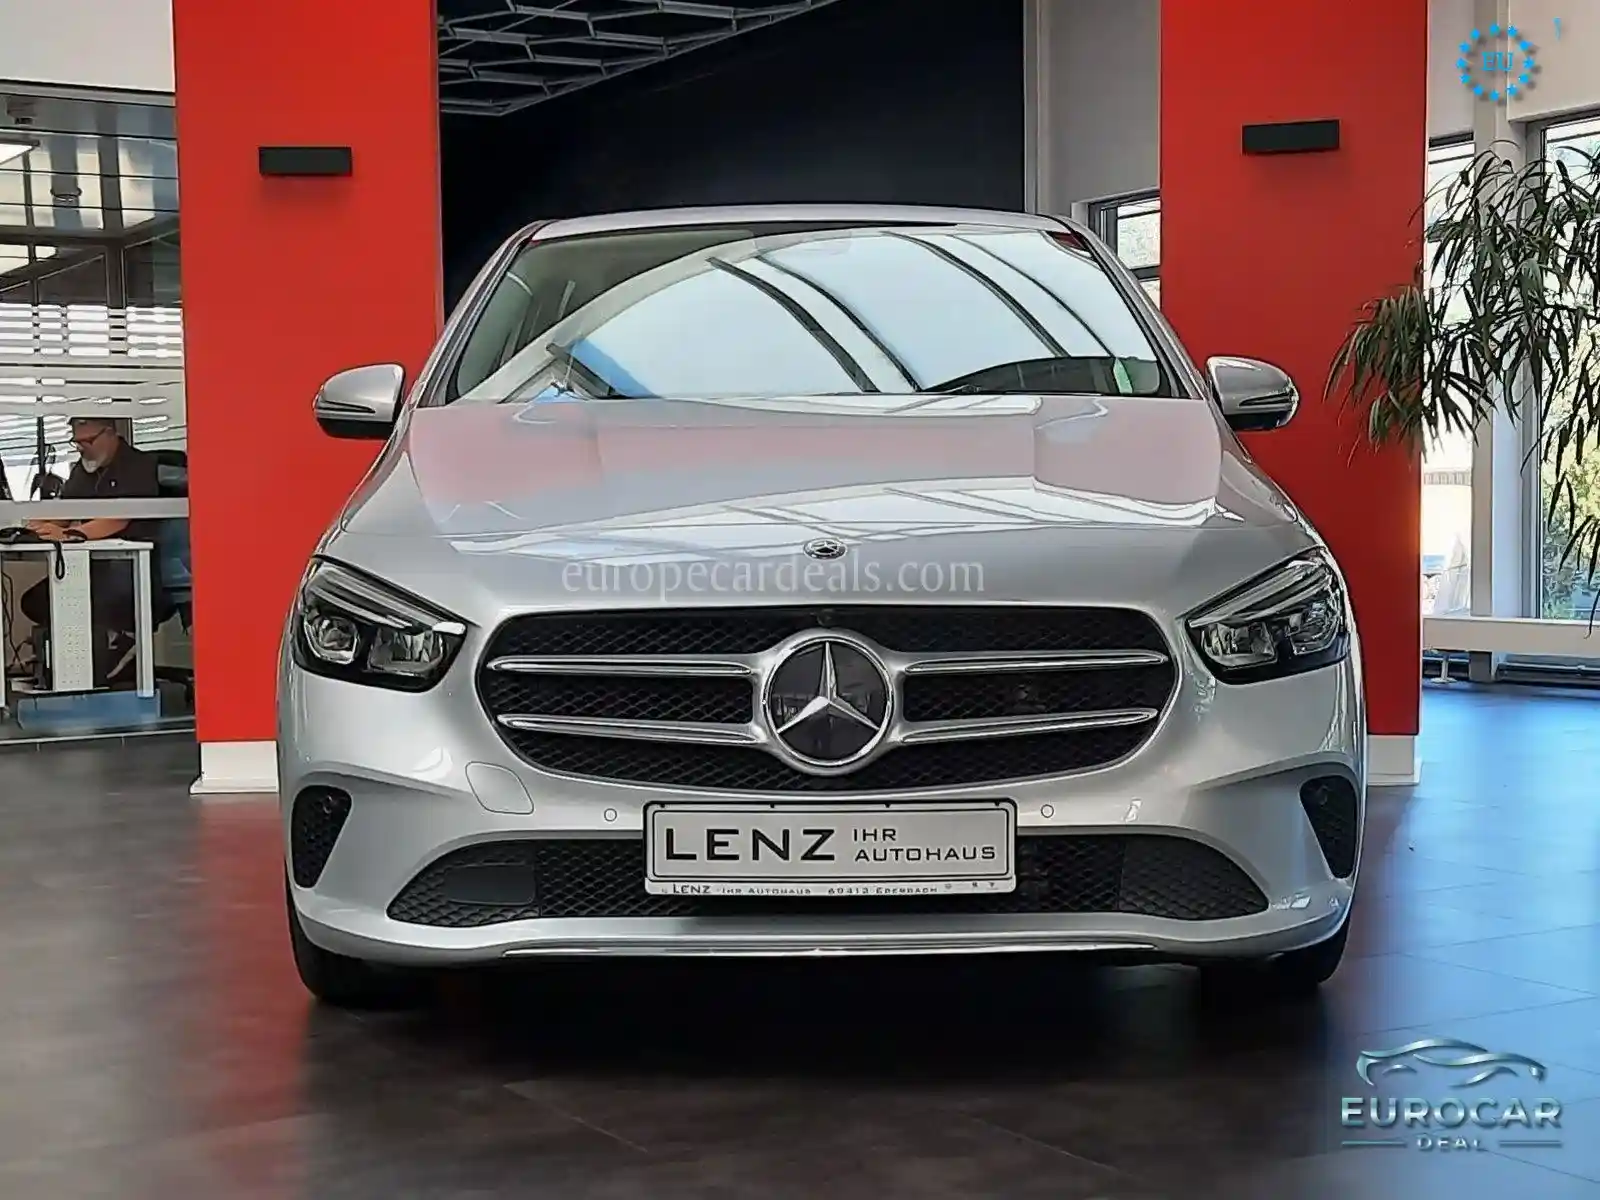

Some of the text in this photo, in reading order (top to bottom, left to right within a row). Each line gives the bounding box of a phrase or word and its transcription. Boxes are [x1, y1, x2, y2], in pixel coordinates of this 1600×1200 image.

[852, 827, 897, 842] IHR
[665, 827, 836, 862] LENZ
[854, 846, 996, 862] AUTOHAUS
[672, 884, 712, 894] LENZ
